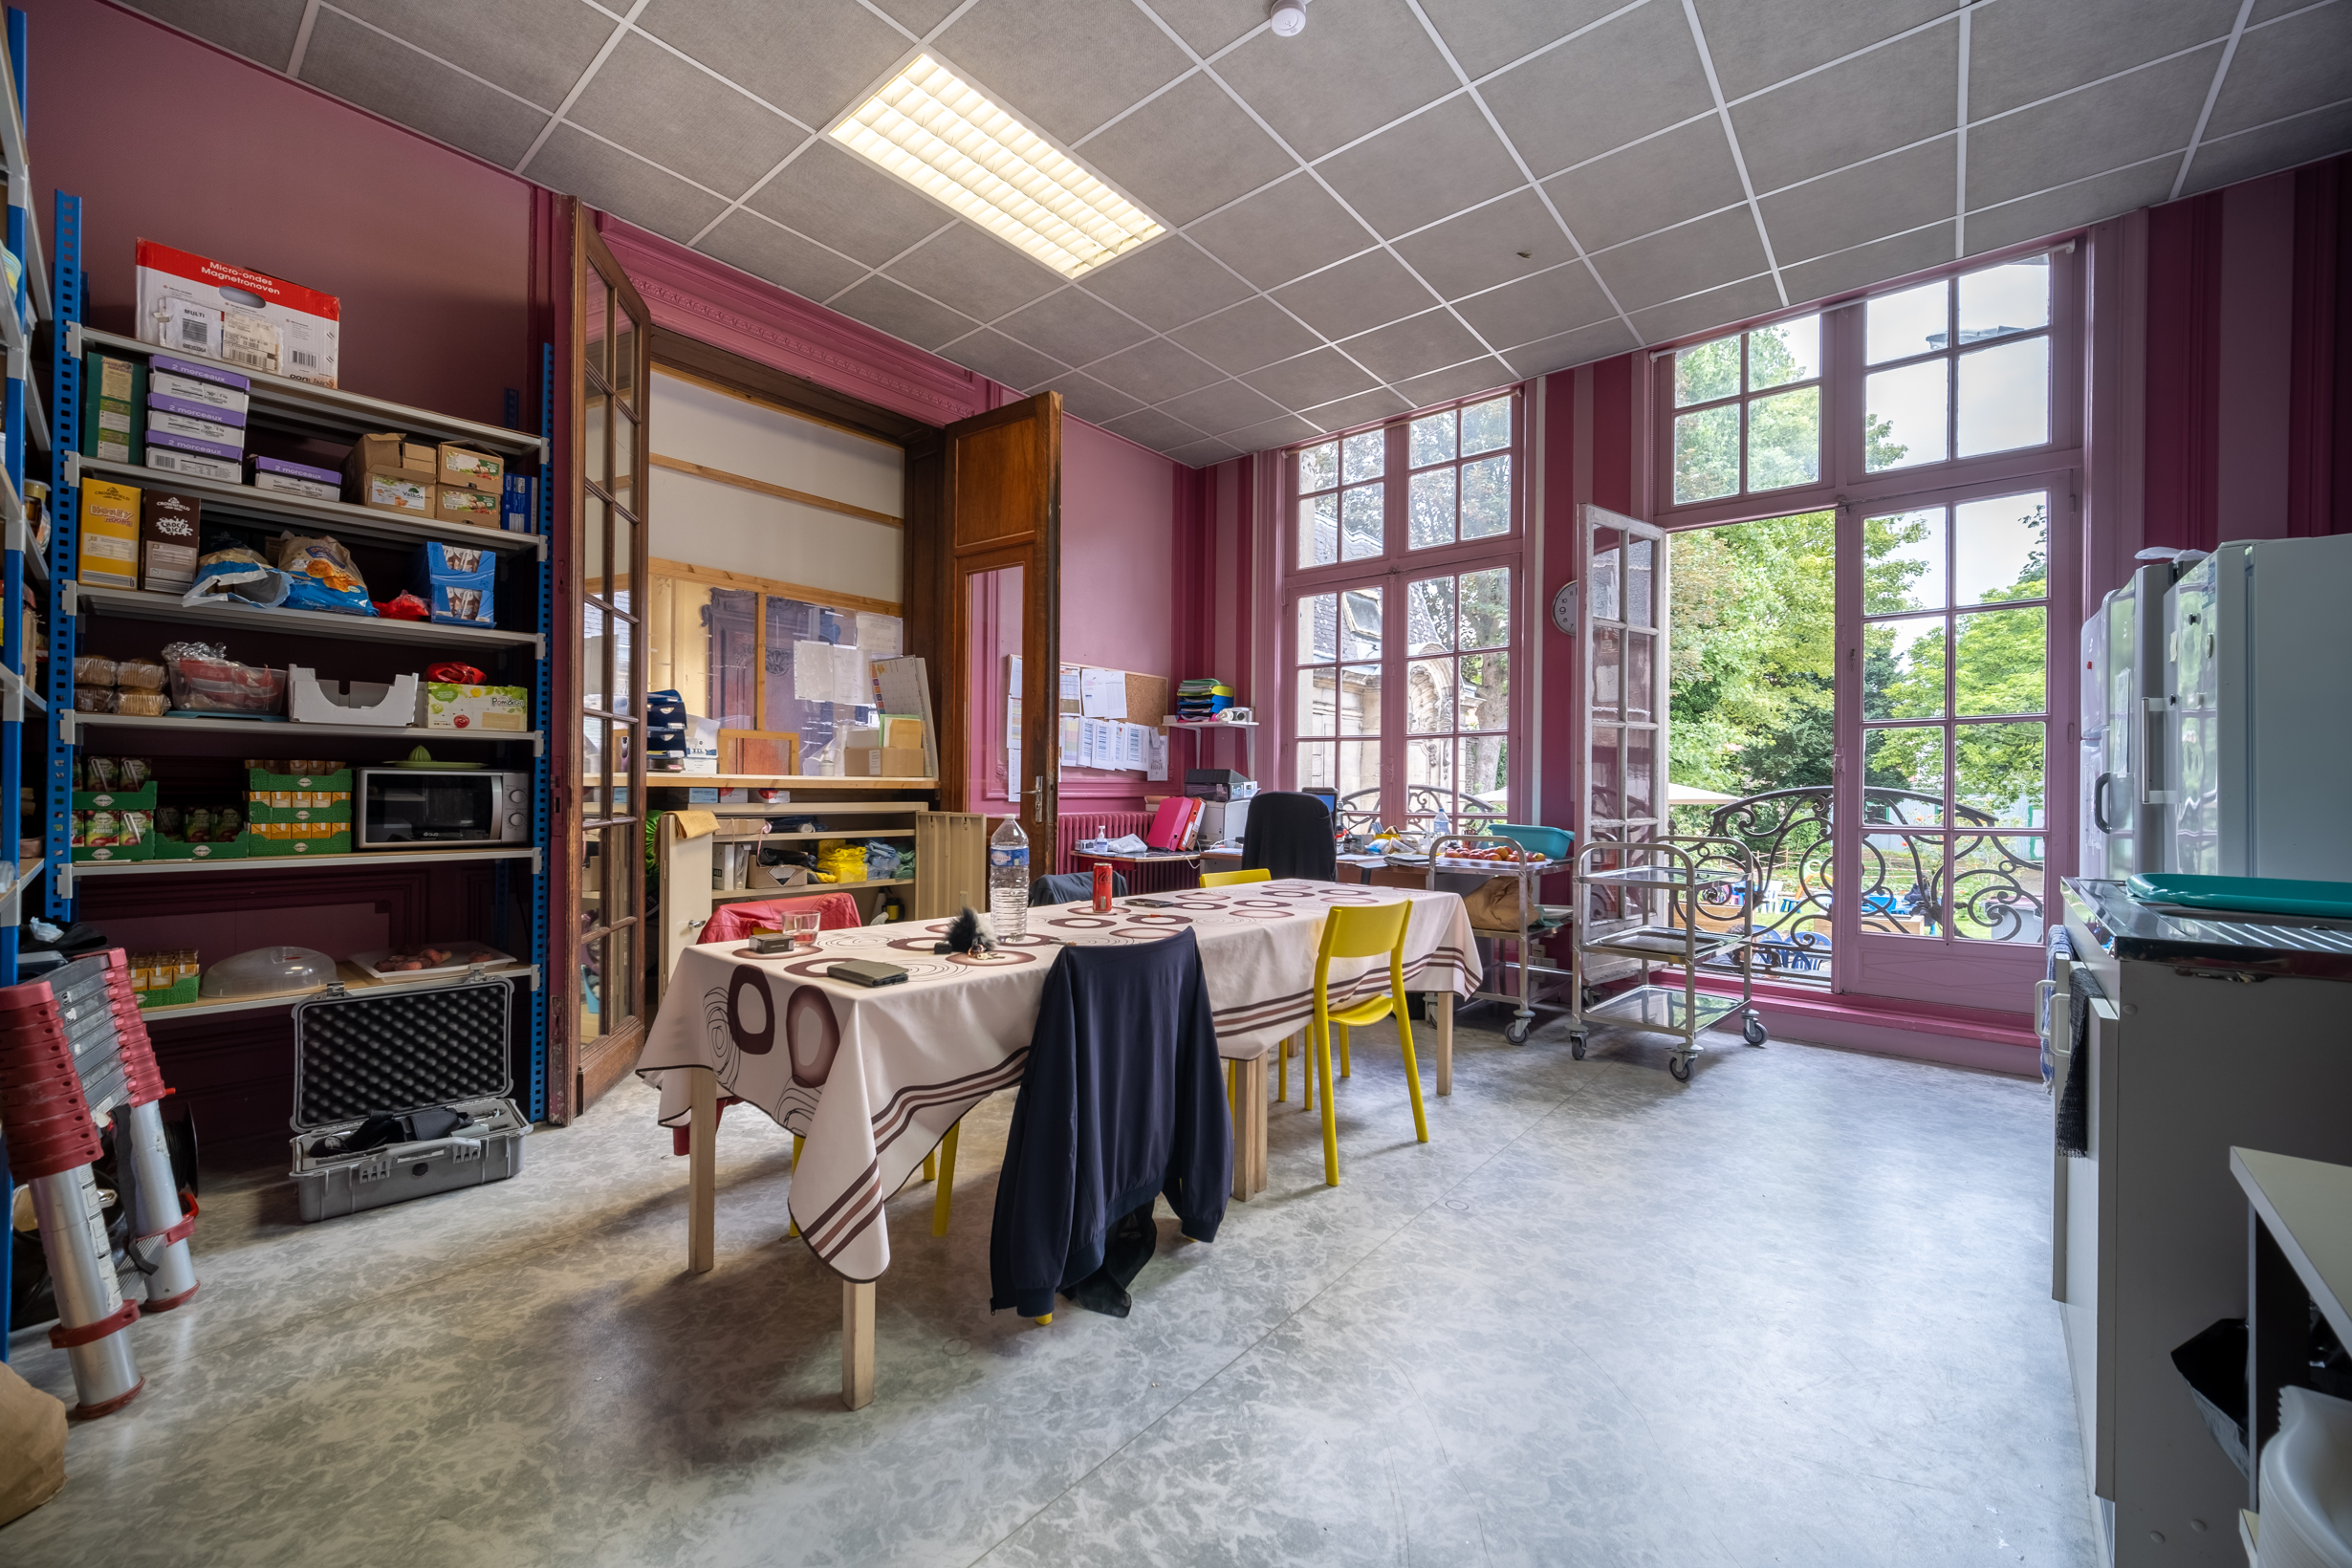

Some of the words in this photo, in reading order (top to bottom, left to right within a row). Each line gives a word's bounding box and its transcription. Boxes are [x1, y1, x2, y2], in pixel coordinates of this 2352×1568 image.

[209, 261, 272, 286] Micro-ondes
[201, 266, 280, 295] Magnetronoven
[184, 308, 206, 318] MULTI
[180, 367, 226, 382] morceaux
[178, 406, 223, 422] morceaux
[177, 442, 222, 456] morceaux
[282, 467, 322, 480] morceaux
[95, 490, 130, 501] CROWNFIELD
[90, 505, 134, 520] HONEY
[156, 501, 190, 512] CROWNFIELD
[104, 517, 134, 528] HOOPS
[161, 521, 186, 530] CHOCO
[1559, 606, 1567, 615] 9
